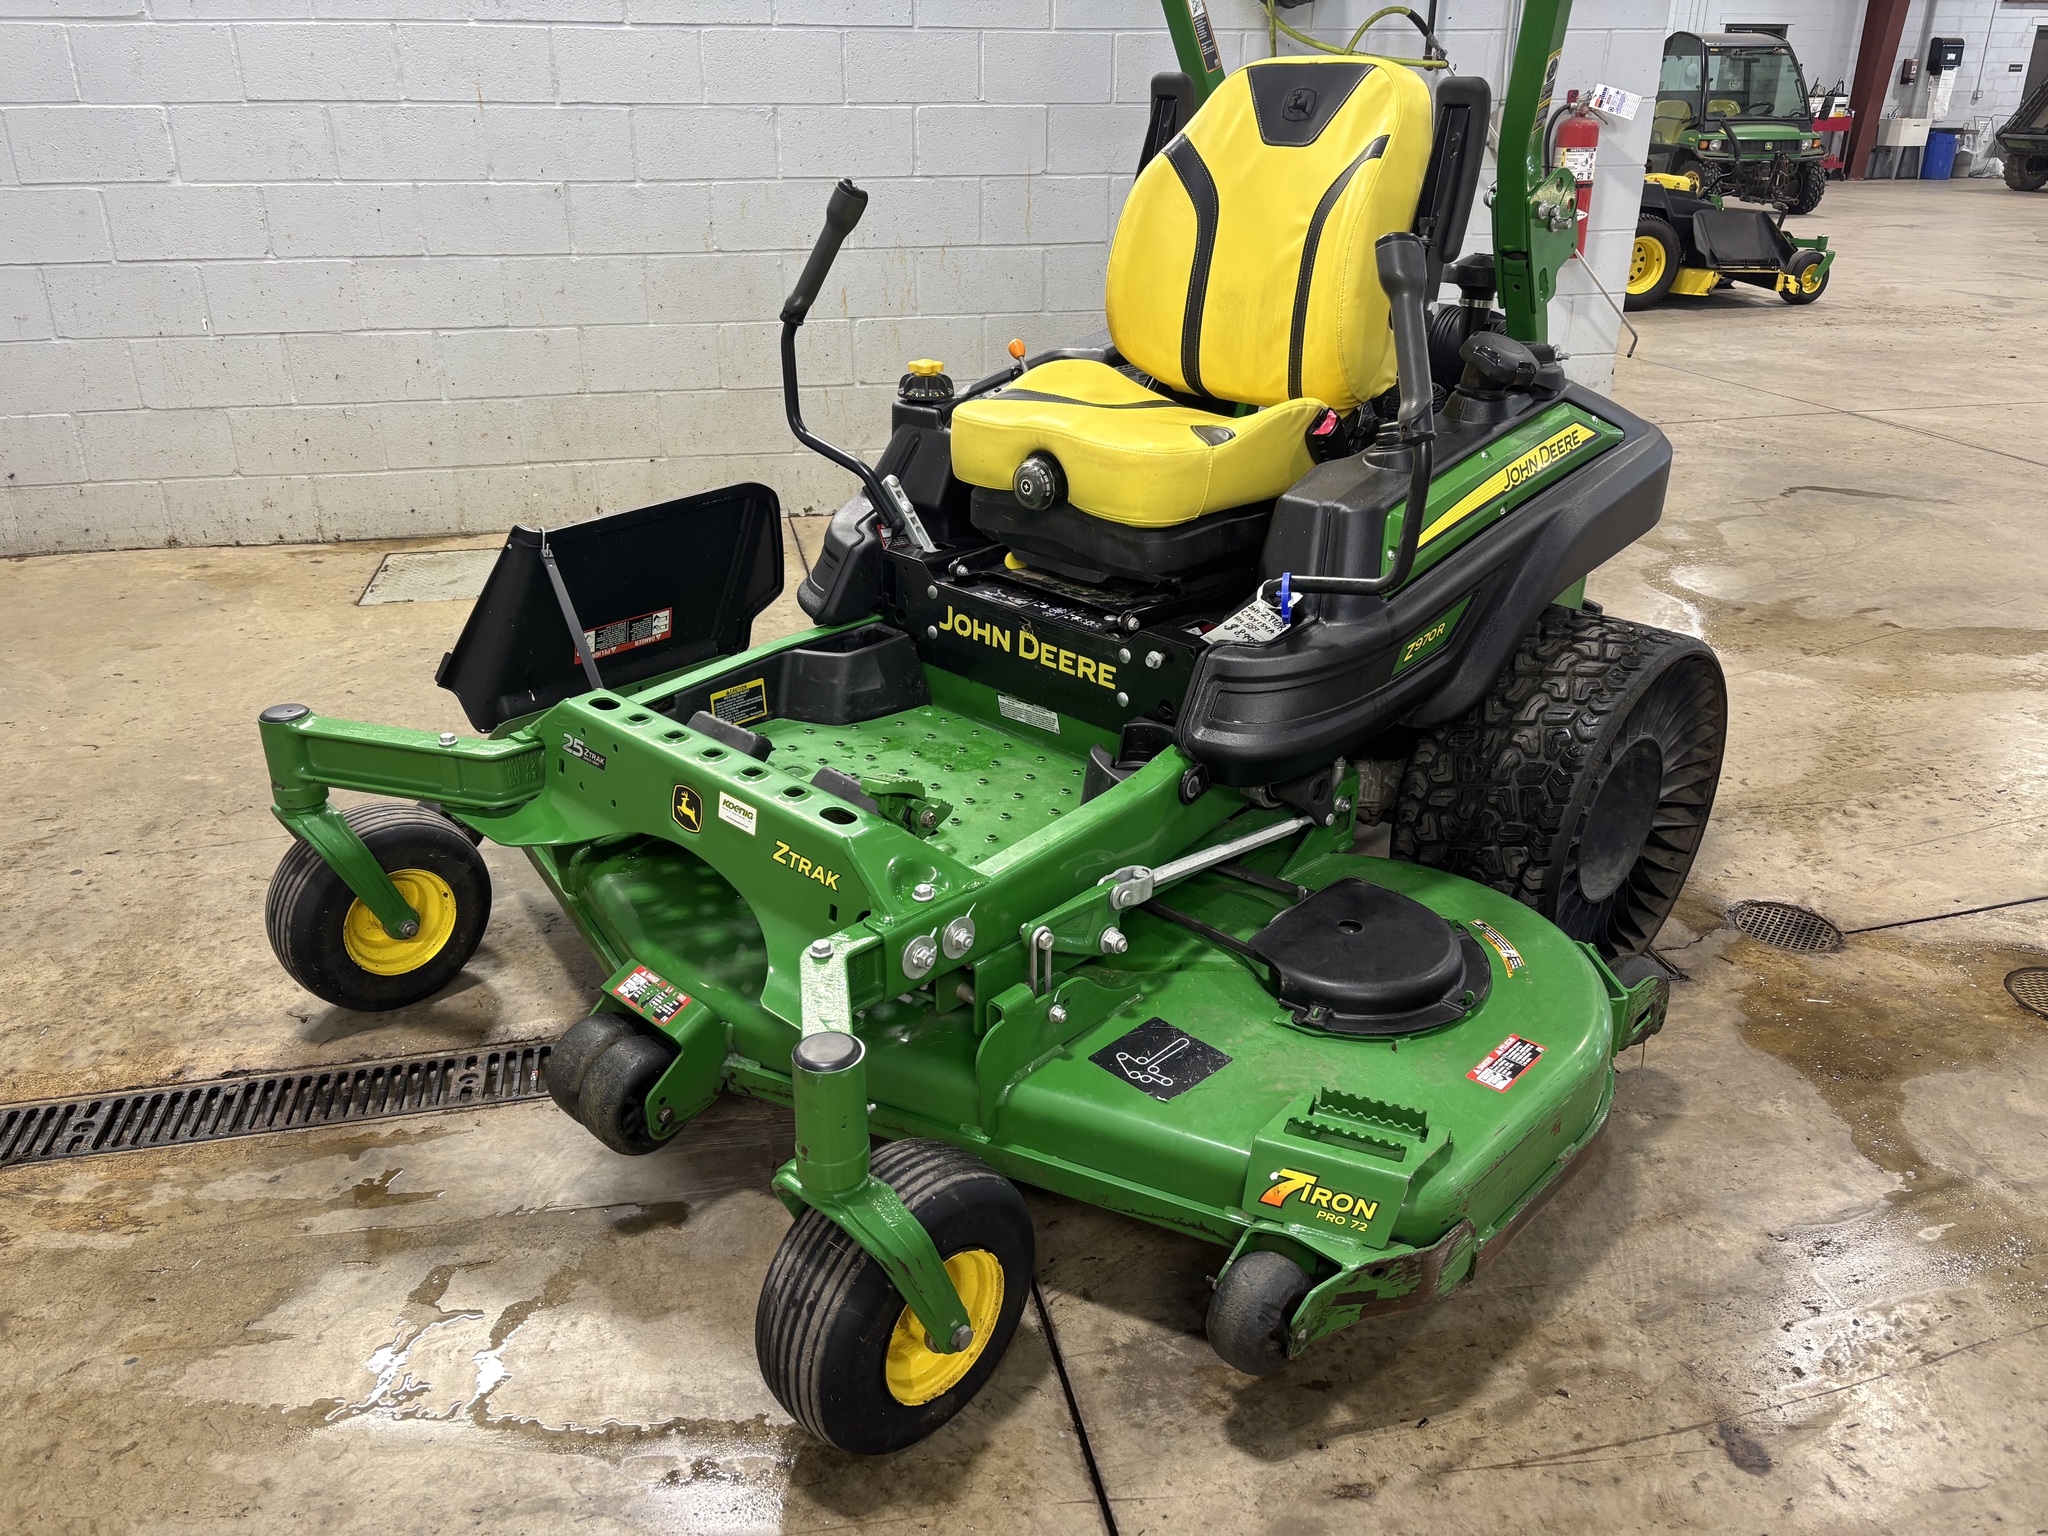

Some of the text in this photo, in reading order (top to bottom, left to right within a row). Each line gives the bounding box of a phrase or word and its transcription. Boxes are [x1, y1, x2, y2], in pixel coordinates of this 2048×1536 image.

[1504, 430, 1581, 490] JOHN DEERE
[634, 635, 656, 646] DANGER
[939, 605, 1010, 653] JOHN
[1018, 630, 1117, 690] DEERE
[1403, 622, 1446, 662] Z970R
[591, 648, 611, 659] PELIGR
[562, 733, 584, 757] 25
[584, 748, 605, 765] ZTRAK
[772, 840, 842, 892] ZTRAK
[1316, 1210, 1369, 1232] PRO 72
